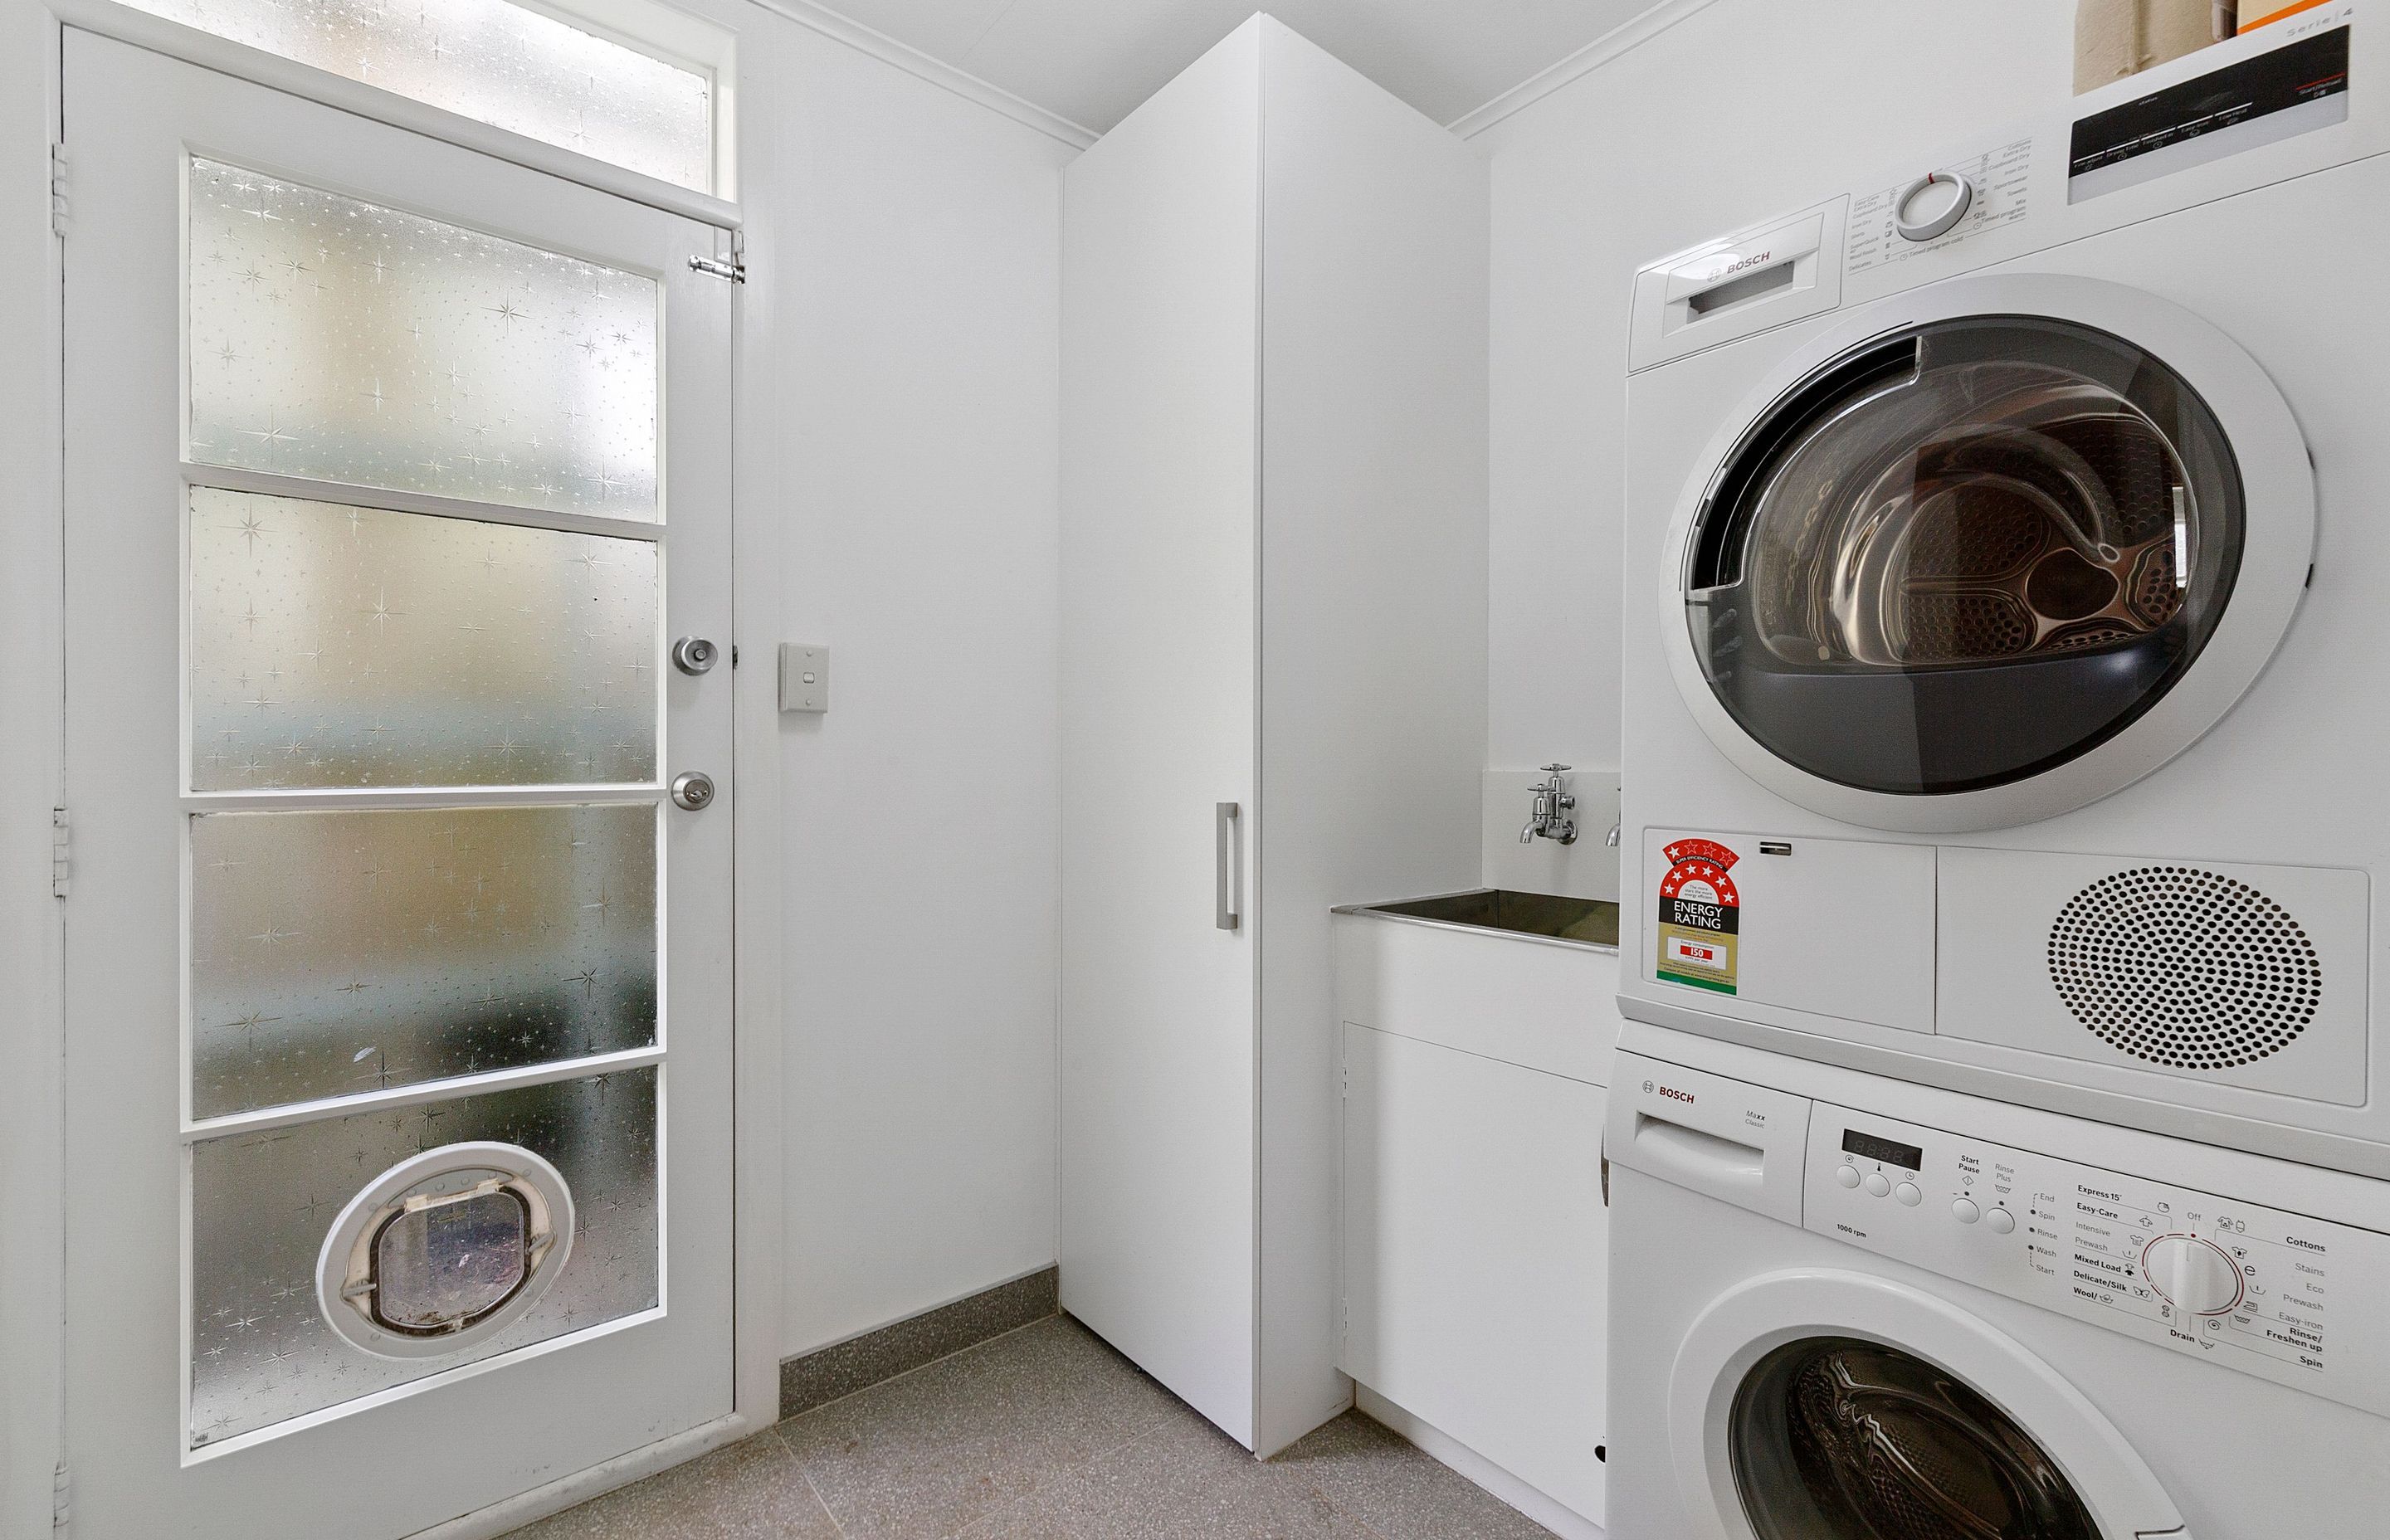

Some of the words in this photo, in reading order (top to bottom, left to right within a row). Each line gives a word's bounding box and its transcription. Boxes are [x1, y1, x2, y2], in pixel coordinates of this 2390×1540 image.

[2286, 17, 2331, 37] Serie
[2343, 7, 2353, 16] 4
[1910, 247, 1926, 257] Timed
[1926, 241, 1950, 252] program
[1951, 236, 1964, 245] cold
[1727, 251, 1770, 274] BOSCH
[1674, 900, 1723, 918] ENERGY
[1675, 912, 1721, 929] RATING
[1690, 948, 1704, 958] 150
[1660, 1086, 1695, 1104] BOSCH
[1746, 1110, 1766, 1121] Maxx
[1745, 1118, 1765, 1129] Classic
[1961, 1154, 1979, 1166] Start
[1958, 1162, 1980, 1174] Pause
[1995, 1163, 2015, 1174] Rinse
[1997, 1172, 2012, 1182] Plus
[2040, 1192, 2055, 1202] End
[2077, 1184, 2110, 1199] Express
[2038, 1211, 2056, 1221] Spin
[2076, 1201, 2119, 1220] Easy-Care
[2187, 1211, 2202, 1221] Off
[1836, 1223, 1852, 1235] 1000
[1853, 1230, 1866, 1239] rpm
[2037, 1228, 2058, 1240] Rinse
[2075, 1221, 2111, 1237] Intensive
[2036, 1245, 2057, 1258] Wash
[2075, 1236, 2108, 1252] Prewash
[2285, 1236, 2326, 1252] Cottons
[2036, 1264, 2055, 1276] Start
[2075, 1253, 2100, 1266] Mixed
[2100, 1260, 2122, 1273] Load
[2295, 1262, 2324, 1277] Stains
[2073, 1270, 2127, 1292] Delicate/Silk
[2306, 1283, 2324, 1294] Eco
[2073, 1286, 2098, 1300] Wool/
[2283, 1294, 2324, 1312] Prewash
[2279, 1311, 2324, 1330] Easy-iron
[2170, 1329, 2195, 1343] Drain
[2266, 1329, 2308, 1348] Freshen
[2310, 1343, 2323, 1352] up
[2290, 1328, 2323, 1343] Rinse/
[2300, 1356, 2323, 1369] Spin
